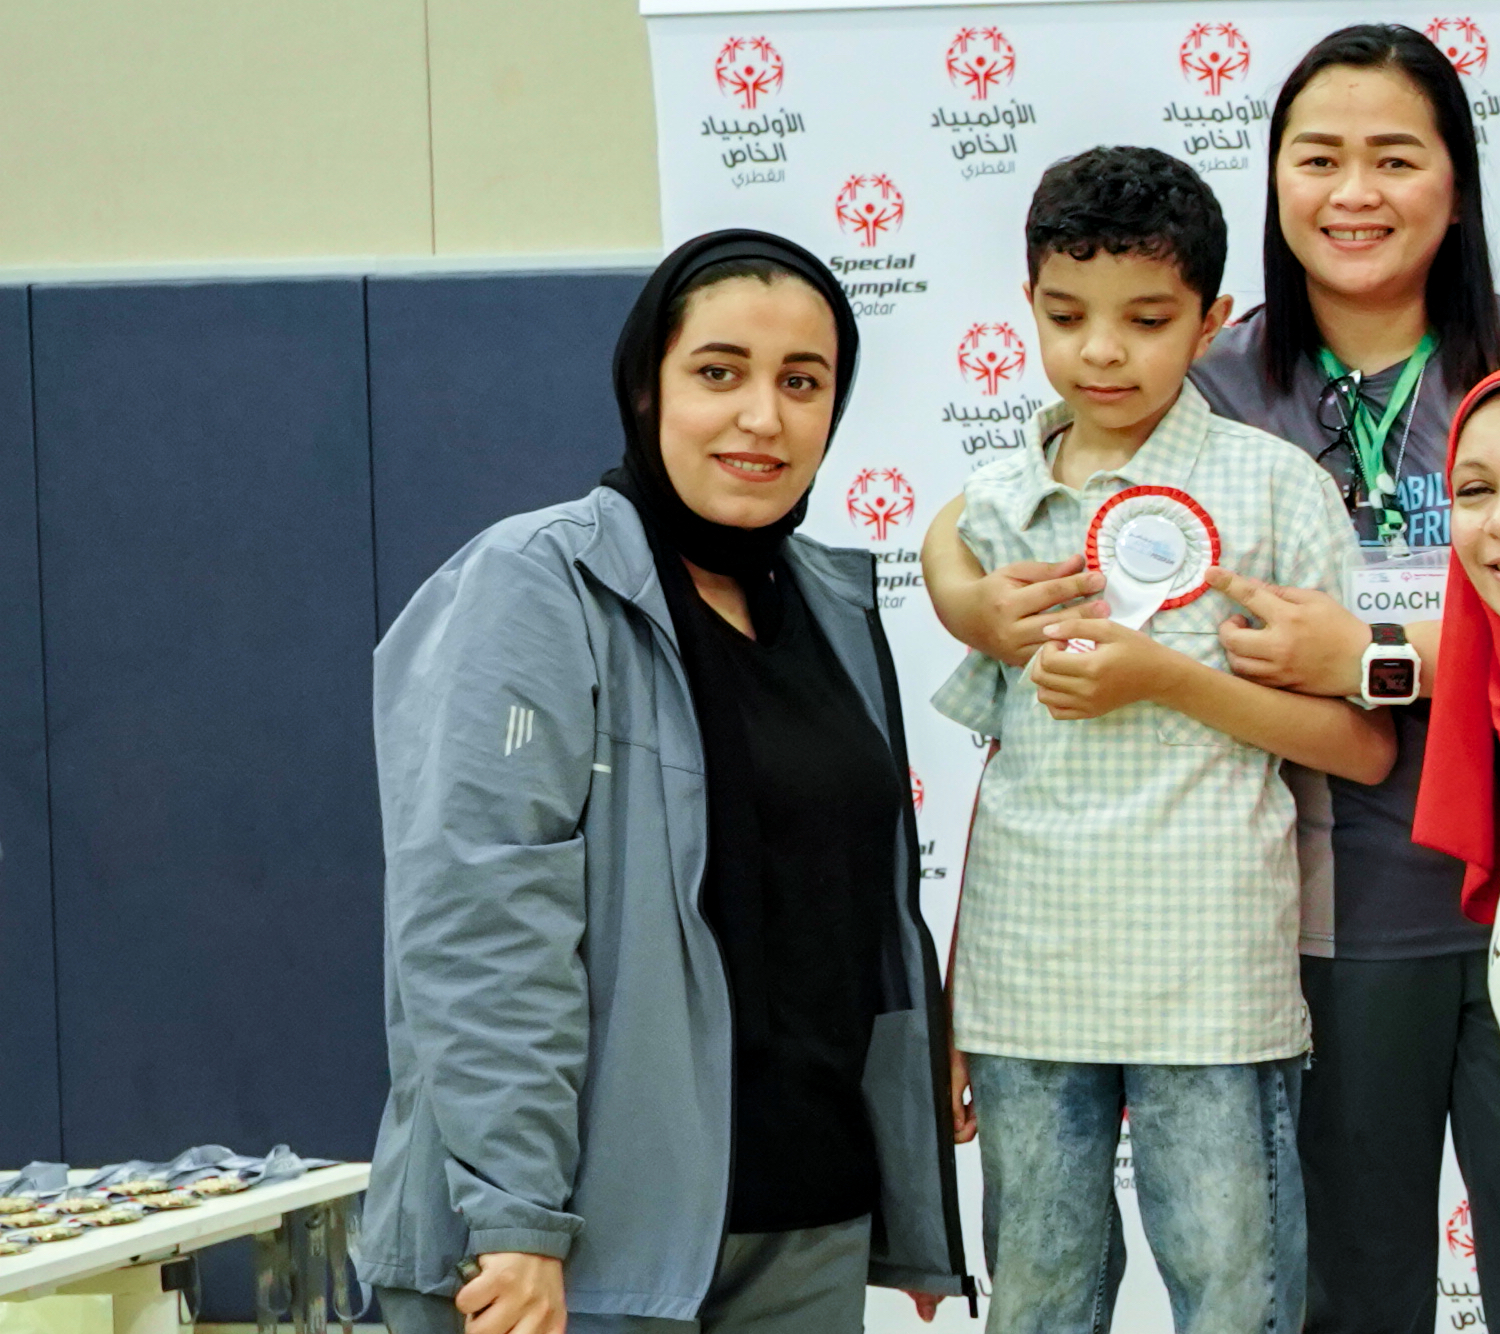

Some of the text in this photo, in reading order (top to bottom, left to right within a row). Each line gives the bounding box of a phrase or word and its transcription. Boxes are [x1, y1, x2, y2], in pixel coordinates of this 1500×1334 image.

[701, 108, 805, 140] الأولمبياد
[931, 99, 1036, 132] الأولمبياد
[1163, 95, 1269, 127] الأولمبياد
[722, 142, 787, 168] الخاص
[952, 133, 1017, 160] الخاص
[1184, 129, 1251, 155] الخاص
[829, 254, 916, 271] Special
[842, 278, 928, 296] ympics
[850, 300, 896, 317] Qatar
[962, 429, 1026, 455] الخاص
[1396, 471, 1451, 512] ABIL
[1356, 591, 1441, 611] COACH
